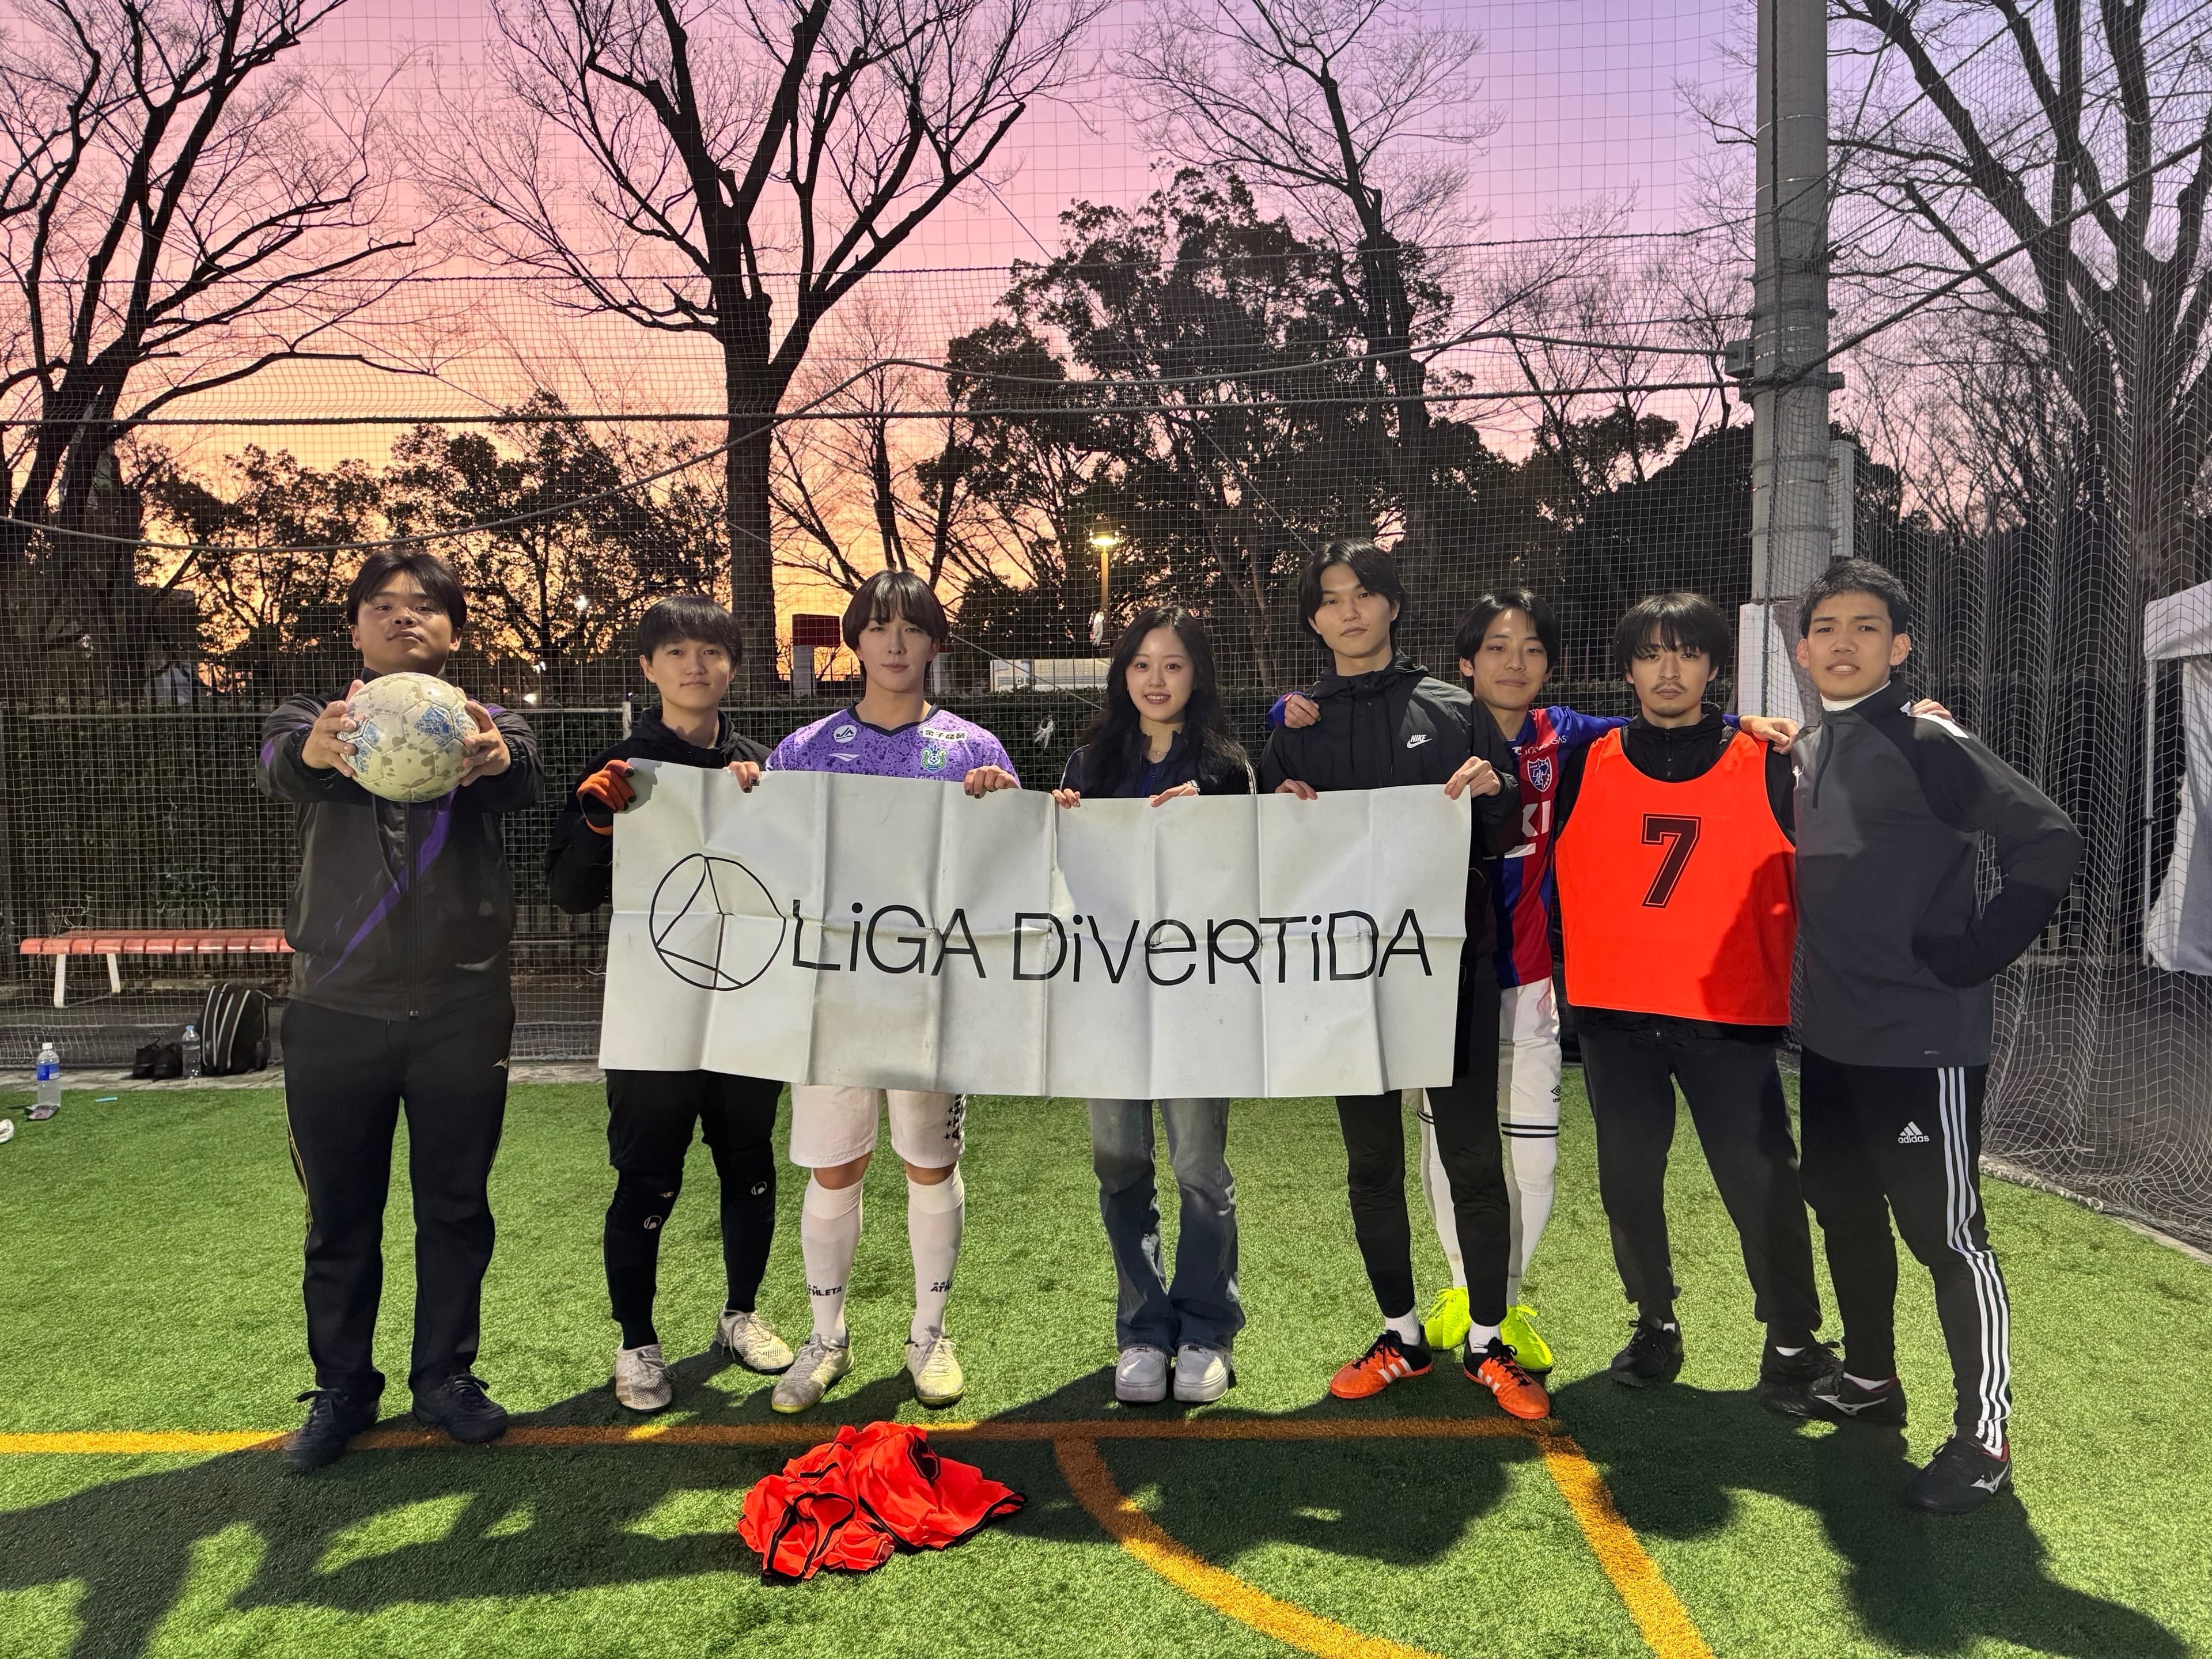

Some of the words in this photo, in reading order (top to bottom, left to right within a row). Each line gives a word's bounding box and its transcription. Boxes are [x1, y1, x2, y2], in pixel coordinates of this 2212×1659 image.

[1410, 734, 1427, 743] NIKE
[1550, 735, 1567, 745] GAS
[1641, 813, 1702, 909] 7
[1897, 1135, 1930, 1143] adidas
[808, 1285, 842, 1296] THLETA
